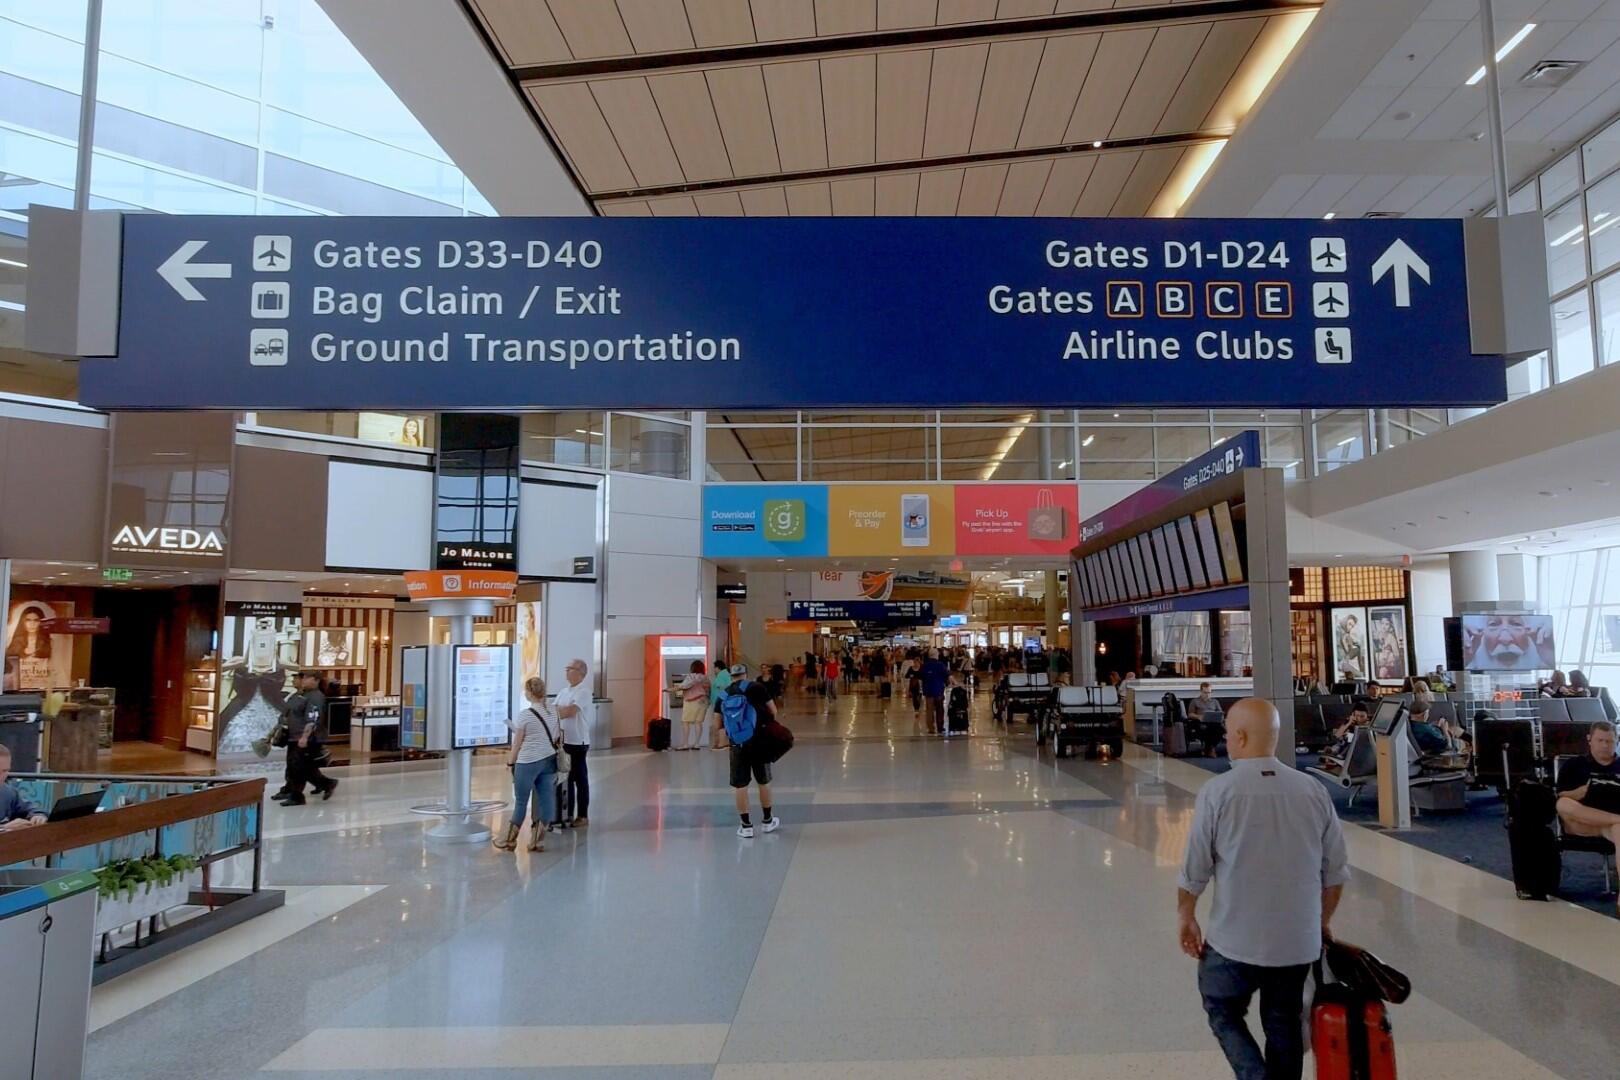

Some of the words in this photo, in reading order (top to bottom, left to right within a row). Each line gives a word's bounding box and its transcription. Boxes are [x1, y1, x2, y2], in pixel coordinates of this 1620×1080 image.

[313, 240, 421, 268] Gates
[438, 240, 602, 269] D33-D40
[1046, 240, 1148, 268] Gates
[1164, 241, 1290, 268] D1-D24
[313, 286, 382, 323] Bag
[399, 285, 503, 315] Claim
[519, 285, 540, 319] /
[555, 285, 621, 315] Exit
[989, 285, 1093, 314] Gates
[1113, 287, 1137, 312] A
[1165, 287, 1185, 312] B
[1214, 287, 1235, 313] C
[1265, 287, 1283, 313] E
[311, 332, 449, 362] Ground
[464, 330, 740, 370] Transportation
[1063, 330, 1180, 360] Airline
[1196, 330, 1293, 360] Clubs
[1183, 474, 1198, 490] Gates
[711, 510, 756, 519] Download
[848, 509, 887, 519] Preorder
[975, 509, 995, 518] Pick
[996, 509, 1009, 519] Up
[111, 524, 224, 551] AVEDA
[441, 546, 457, 556] JO
[461, 547, 513, 560] MALONE
[818, 570, 843, 582] Year
